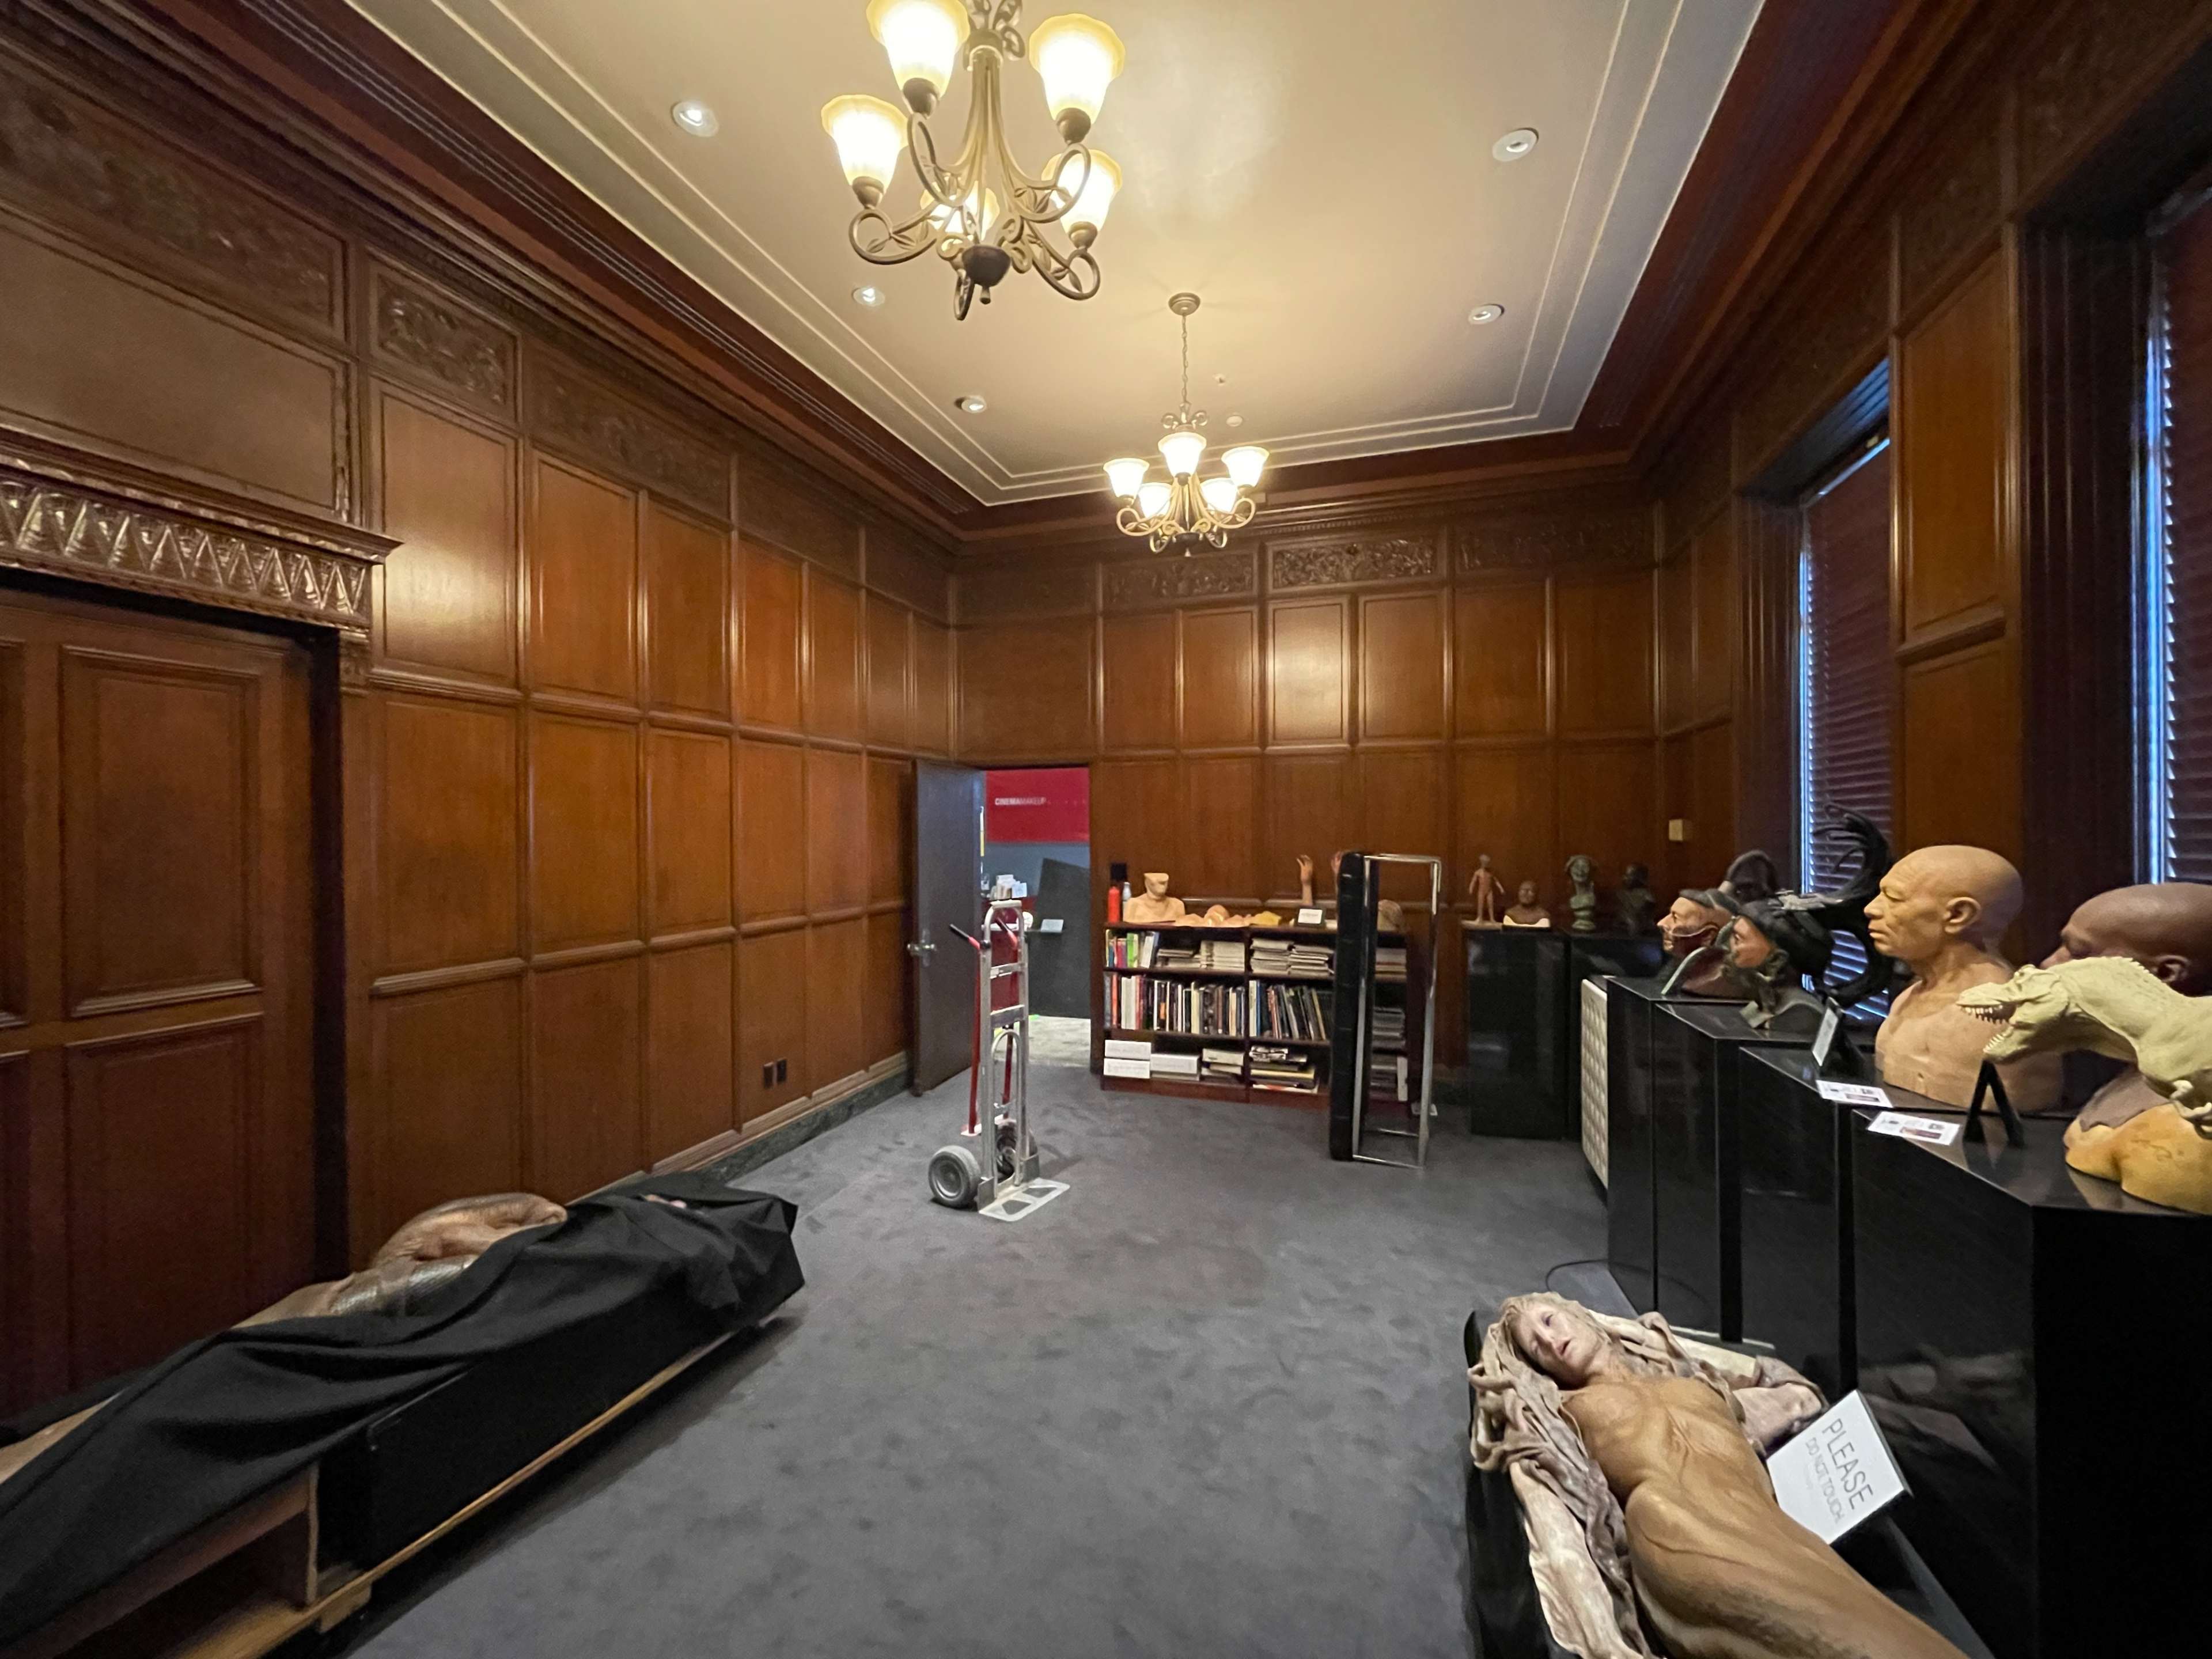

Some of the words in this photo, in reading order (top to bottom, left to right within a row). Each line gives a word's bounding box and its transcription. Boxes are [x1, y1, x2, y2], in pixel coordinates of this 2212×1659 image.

[1805, 1437, 1820, 1456] DO
[1822, 1418, 1873, 1510] PLEASE
[1815, 1454, 1830, 1481] NOT
[1821, 1477, 1845, 1524] TOUCH
